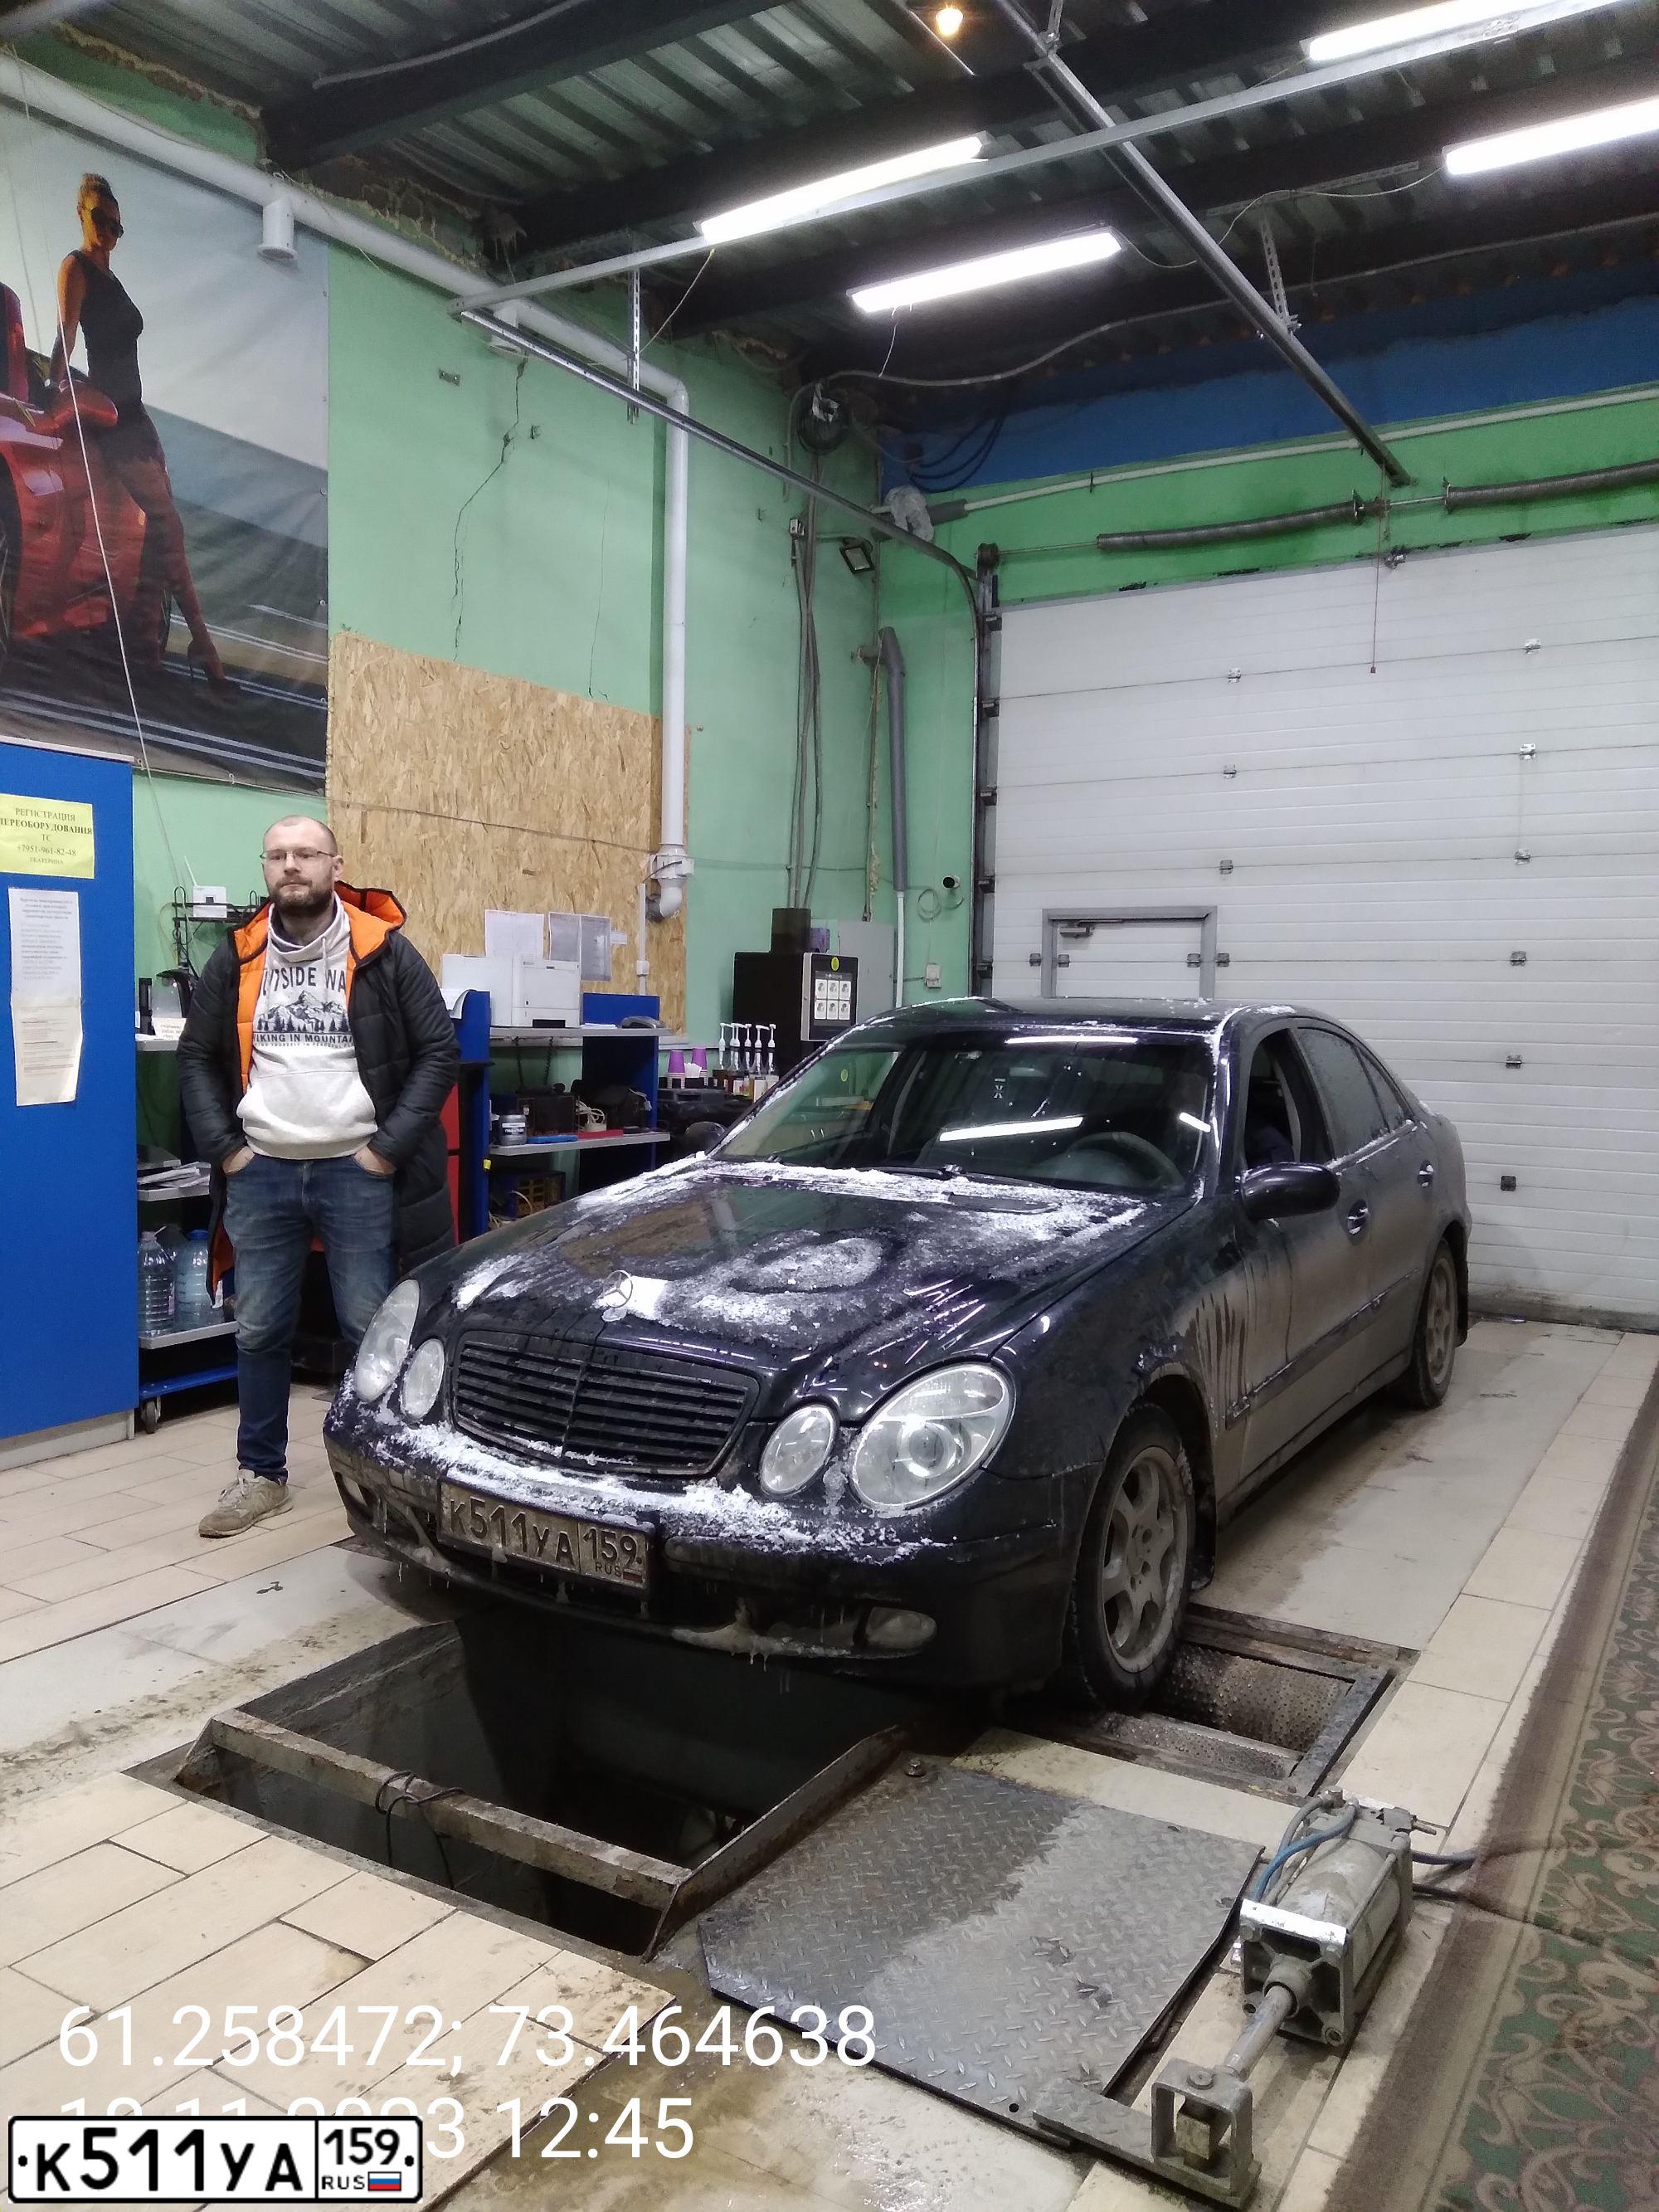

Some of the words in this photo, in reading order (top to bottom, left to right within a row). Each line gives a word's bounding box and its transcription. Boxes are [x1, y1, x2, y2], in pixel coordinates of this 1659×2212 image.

[15, 807, 75, 821] РЕГИСТРАЦИЯ
[290, 1034, 300, 1042] IN
[450, 1496, 575, 1566] К511УА
[583, 1527, 637, 1569] 159
[596, 1562, 620, 1577] RUS
